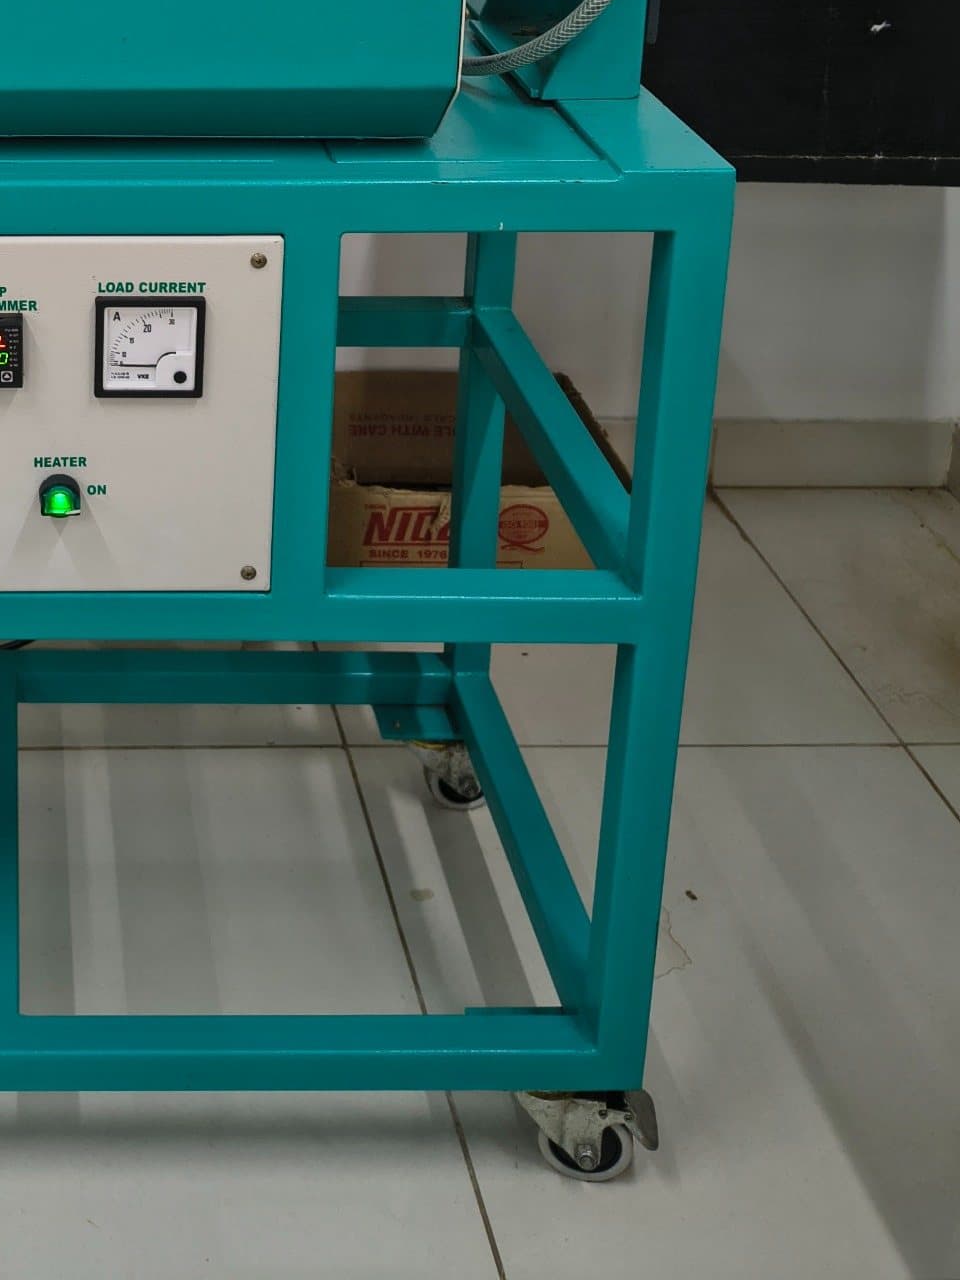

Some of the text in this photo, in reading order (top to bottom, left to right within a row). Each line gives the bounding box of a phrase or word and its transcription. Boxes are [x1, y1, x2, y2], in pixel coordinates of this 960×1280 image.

[98, 282, 207, 293] LOAD CURRENT
[113, 311, 121, 322] A
[143, 324, 152, 333] 20
[33, 456, 87, 468] HEATER
[87, 484, 107, 496] ON
[368, 550, 409, 560] SINCE
